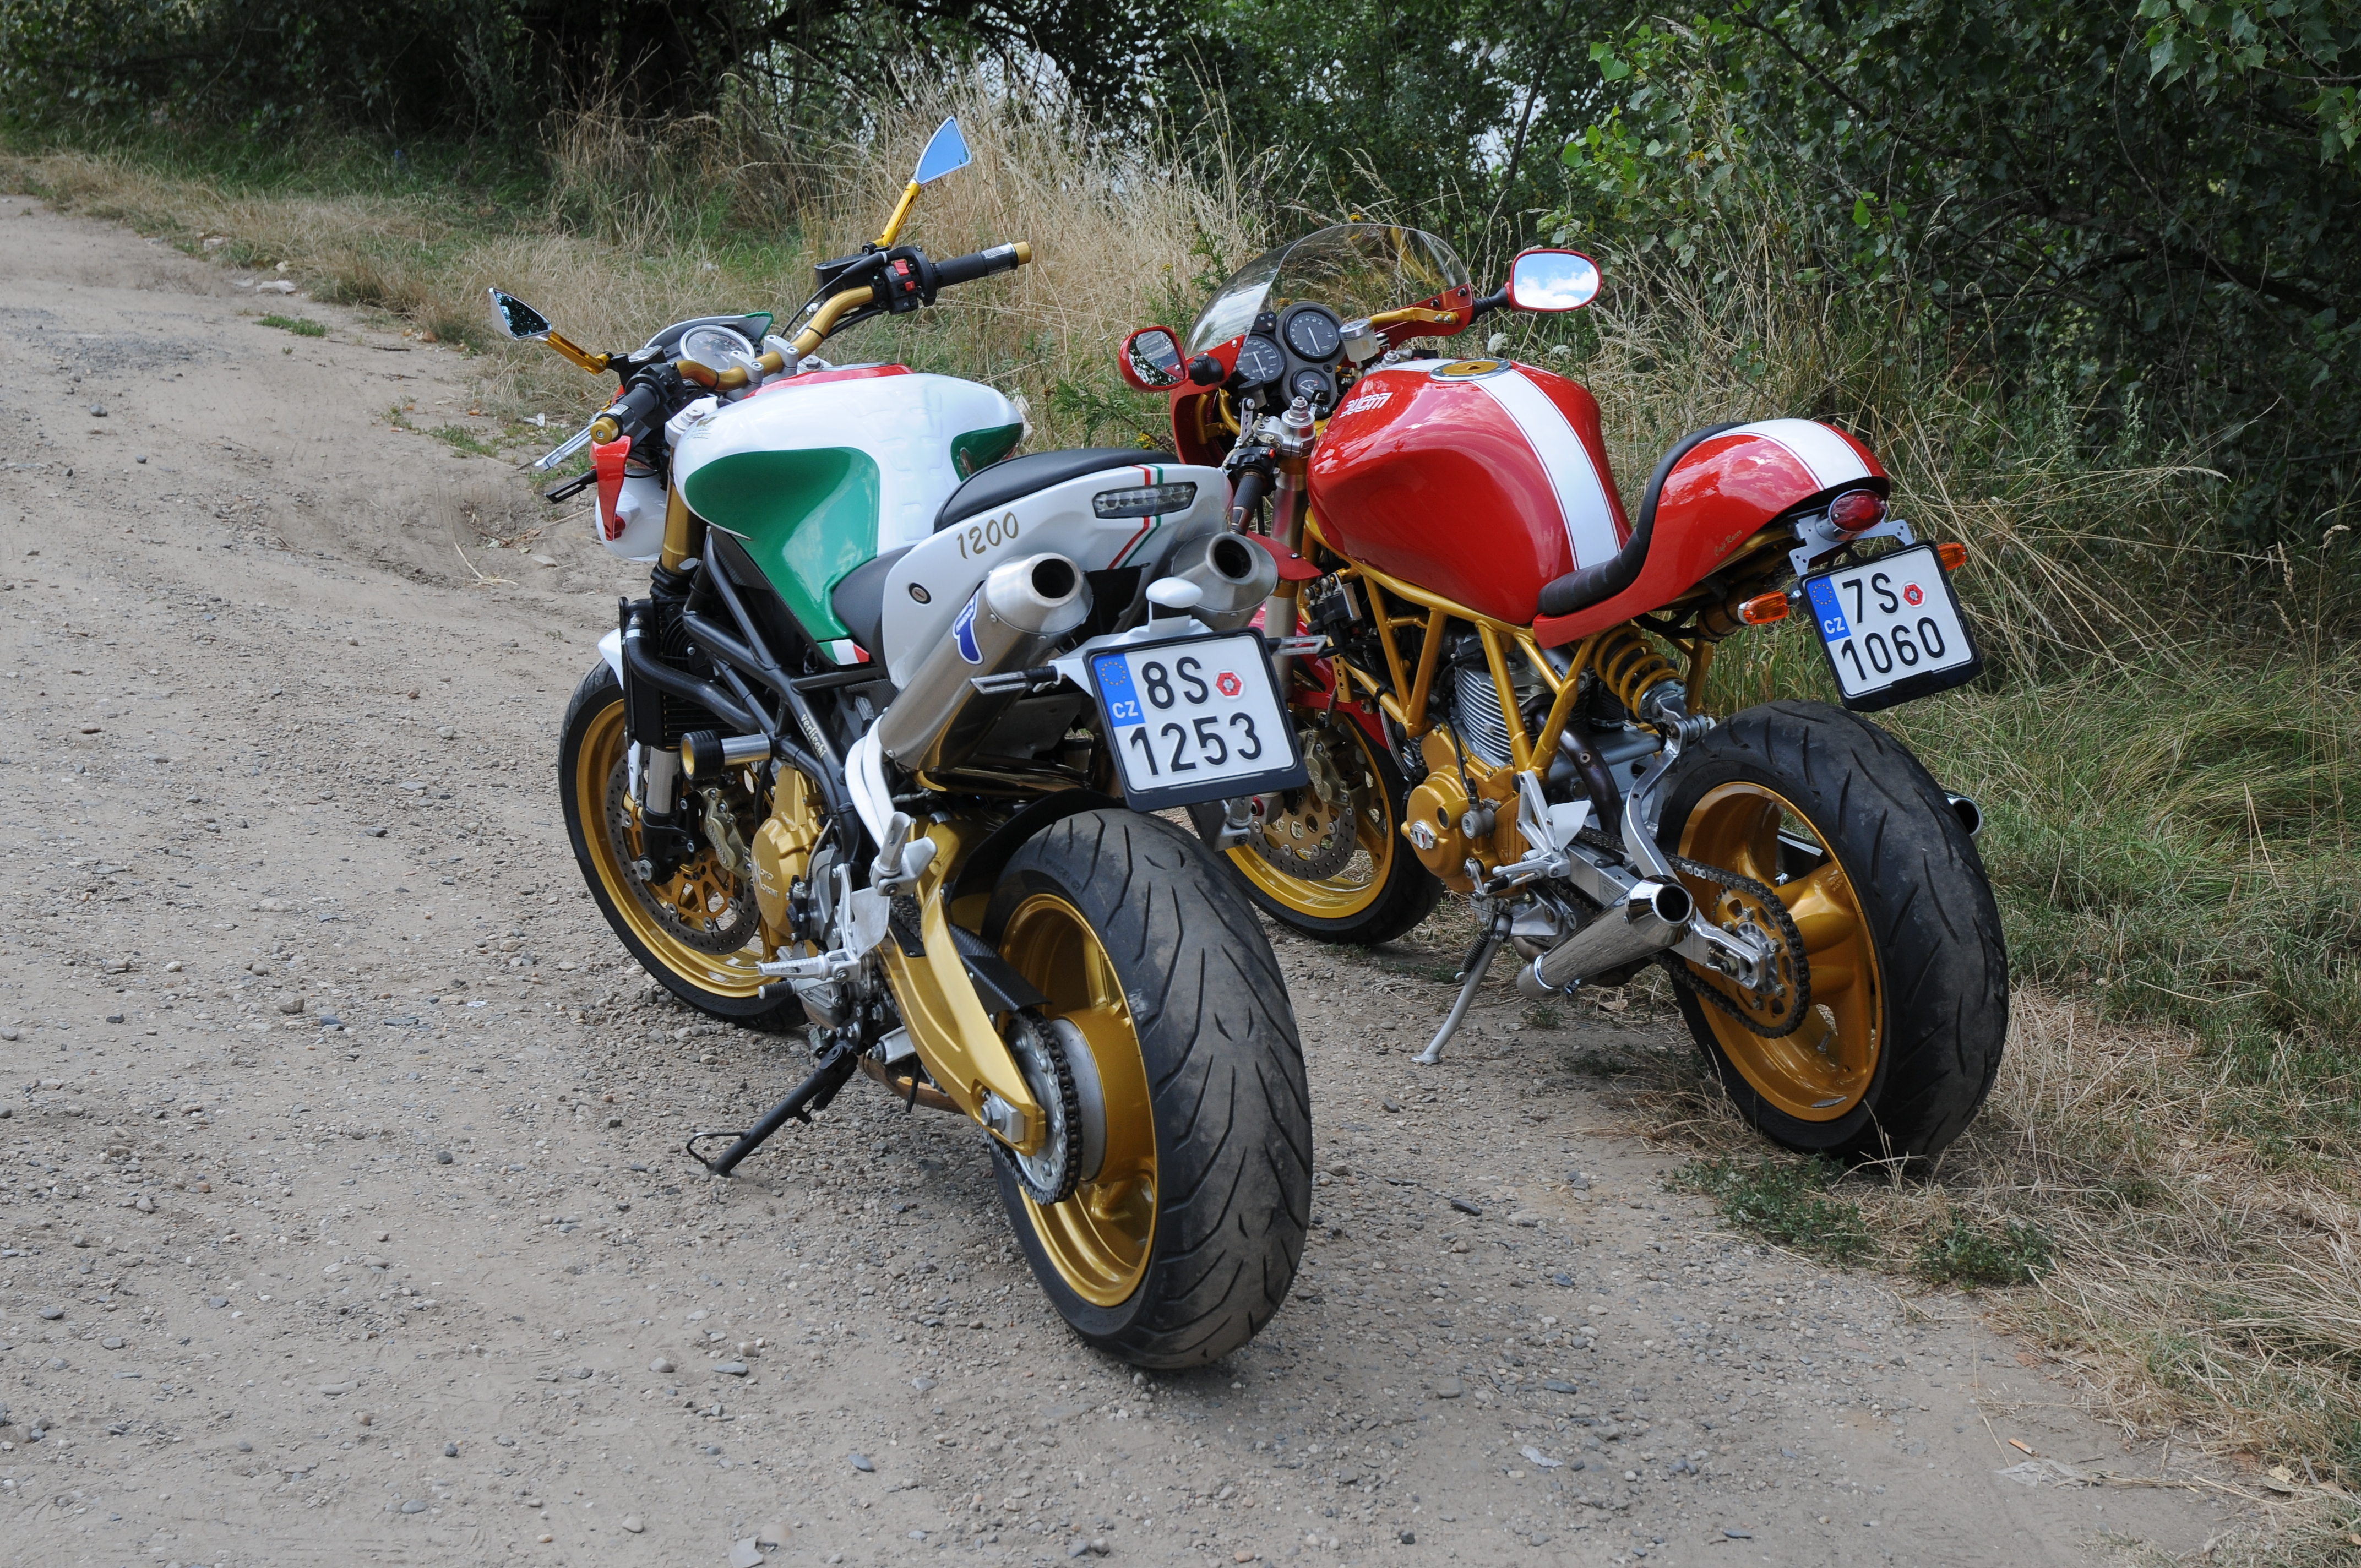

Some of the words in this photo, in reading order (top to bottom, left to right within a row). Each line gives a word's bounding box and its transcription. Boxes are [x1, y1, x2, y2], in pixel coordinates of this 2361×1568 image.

[957, 511, 1019, 560] 1200
[1841, 572, 1899, 625] 7S
[1823, 617, 1846, 635] CZ
[1840, 616, 1945, 681] 1060
[1141, 656, 1209, 710] 8S
[1111, 700, 1139, 719] CZ
[801, 713, 827, 759] verlicchi
[1130, 712, 1263, 776] 1253
